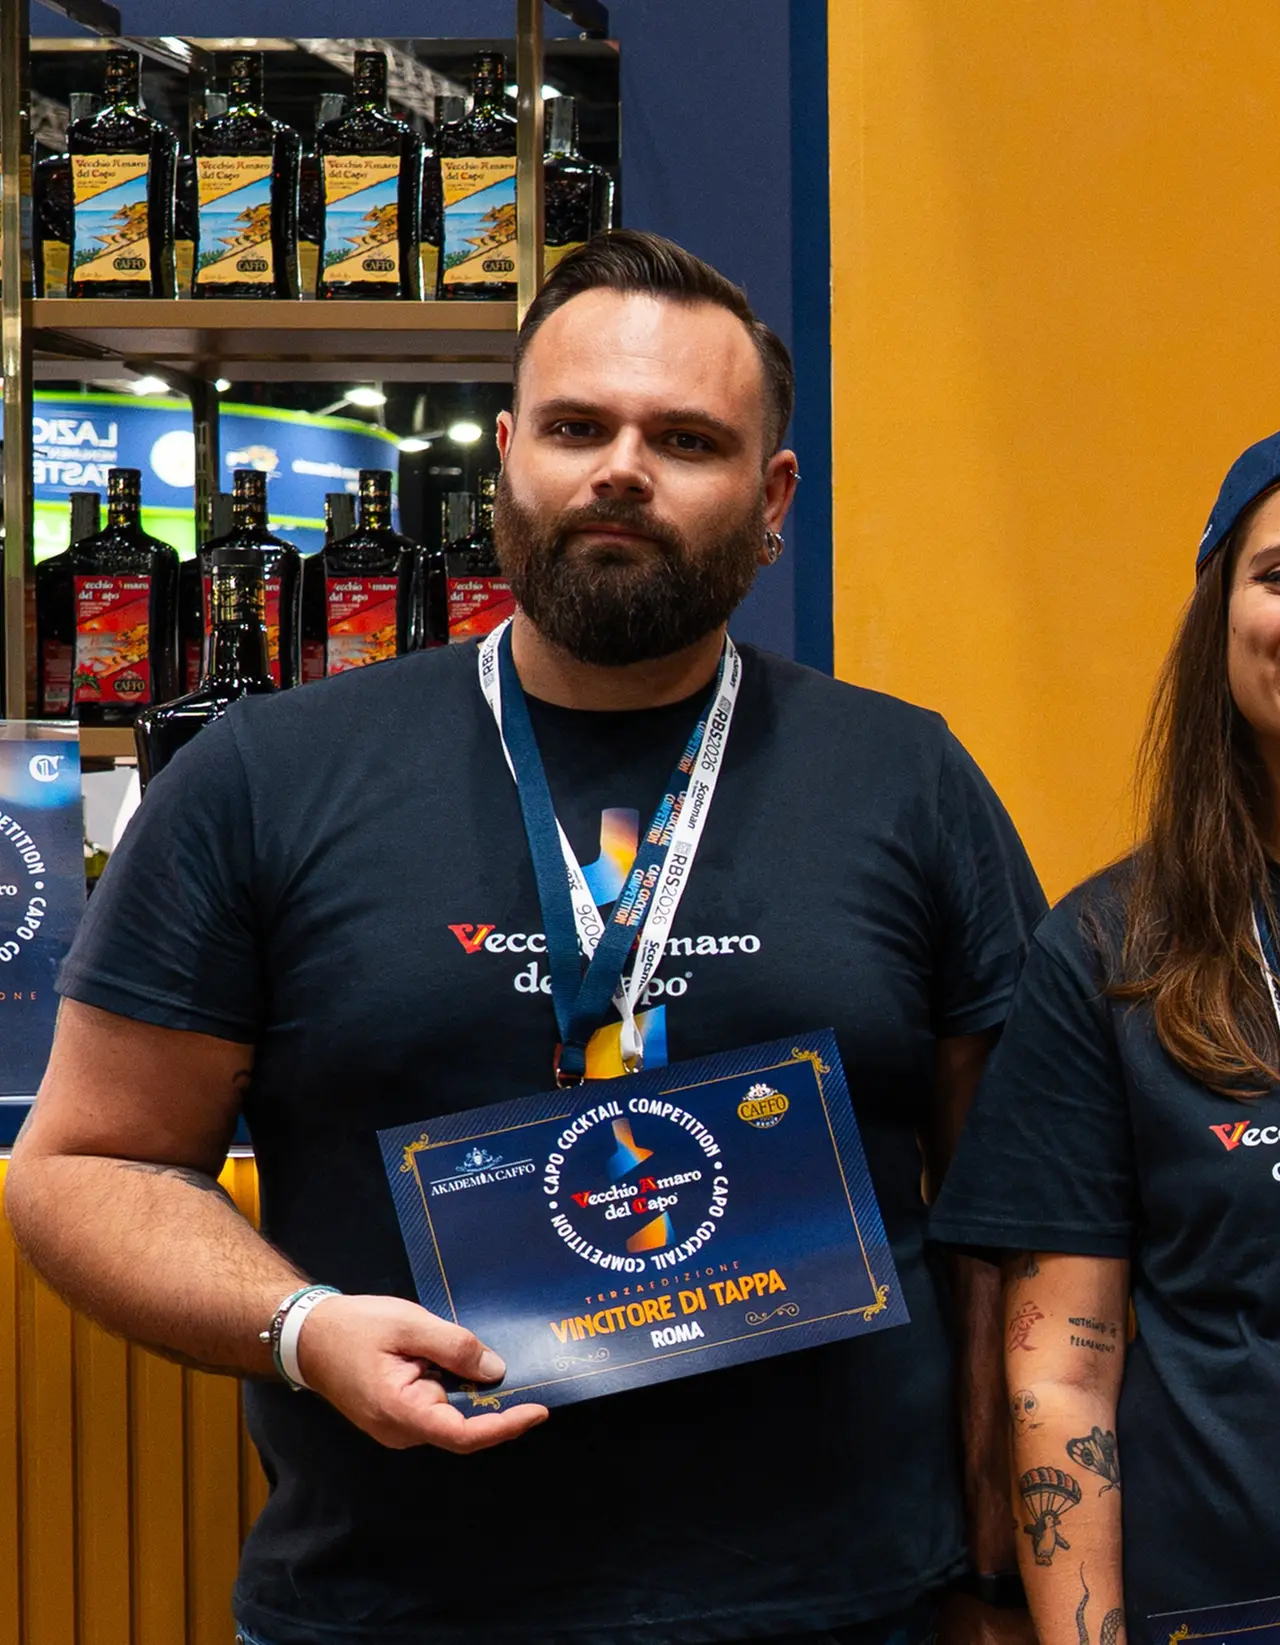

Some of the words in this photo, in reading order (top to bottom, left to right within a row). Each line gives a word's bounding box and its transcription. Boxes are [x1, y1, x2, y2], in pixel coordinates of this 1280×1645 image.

[76, 169, 90, 177] del
[201, 171, 214, 179] del
[329, 170, 342, 178] del
[445, 172, 459, 180] del
[114, 260, 145, 270] CAFFO
[237, 261, 268, 271] CAFFO
[364, 261, 394, 271] CAFFO
[484, 261, 514, 271] CAFFO
[115, 680, 145, 691] CAFFO
[701, 708, 729, 773] RBS2026
[688, 782, 710, 829] Scotsman
[642, 864, 661, 888] CAPO
[652, 853, 688, 925] RBS2026
[613, 869, 645, 925] COMPETITION
[626, 888, 651, 927] COCKTAIL
[17, 897, 47, 941] CAPO
[664, 933, 761, 957] maro
[740, 1095, 786, 1119] CAFFO
[543, 1153, 565, 1195] CAPO
[557, 1101, 624, 1150] COCKTAIL
[628, 1098, 722, 1158] COMPETITION
[431, 1172, 495, 1197] AKADEMIA
[495, 1163, 536, 1181] CAFFO
[571, 1183, 638, 1209] Vecchio
[639, 1170, 702, 1193] Amaro
[604, 1203, 632, 1221] del
[632, 1193, 678, 1215] Capo
[708, 1176, 729, 1219] CAPO
[551, 1213, 646, 1273] COMPETITION
[651, 1221, 716, 1271] COCKTAIL
[549, 1294, 676, 1345] VINCITORE
[678, 1287, 708, 1315] DI
[708, 1268, 787, 1307] TAPPA
[650, 1320, 705, 1349] ROMA
